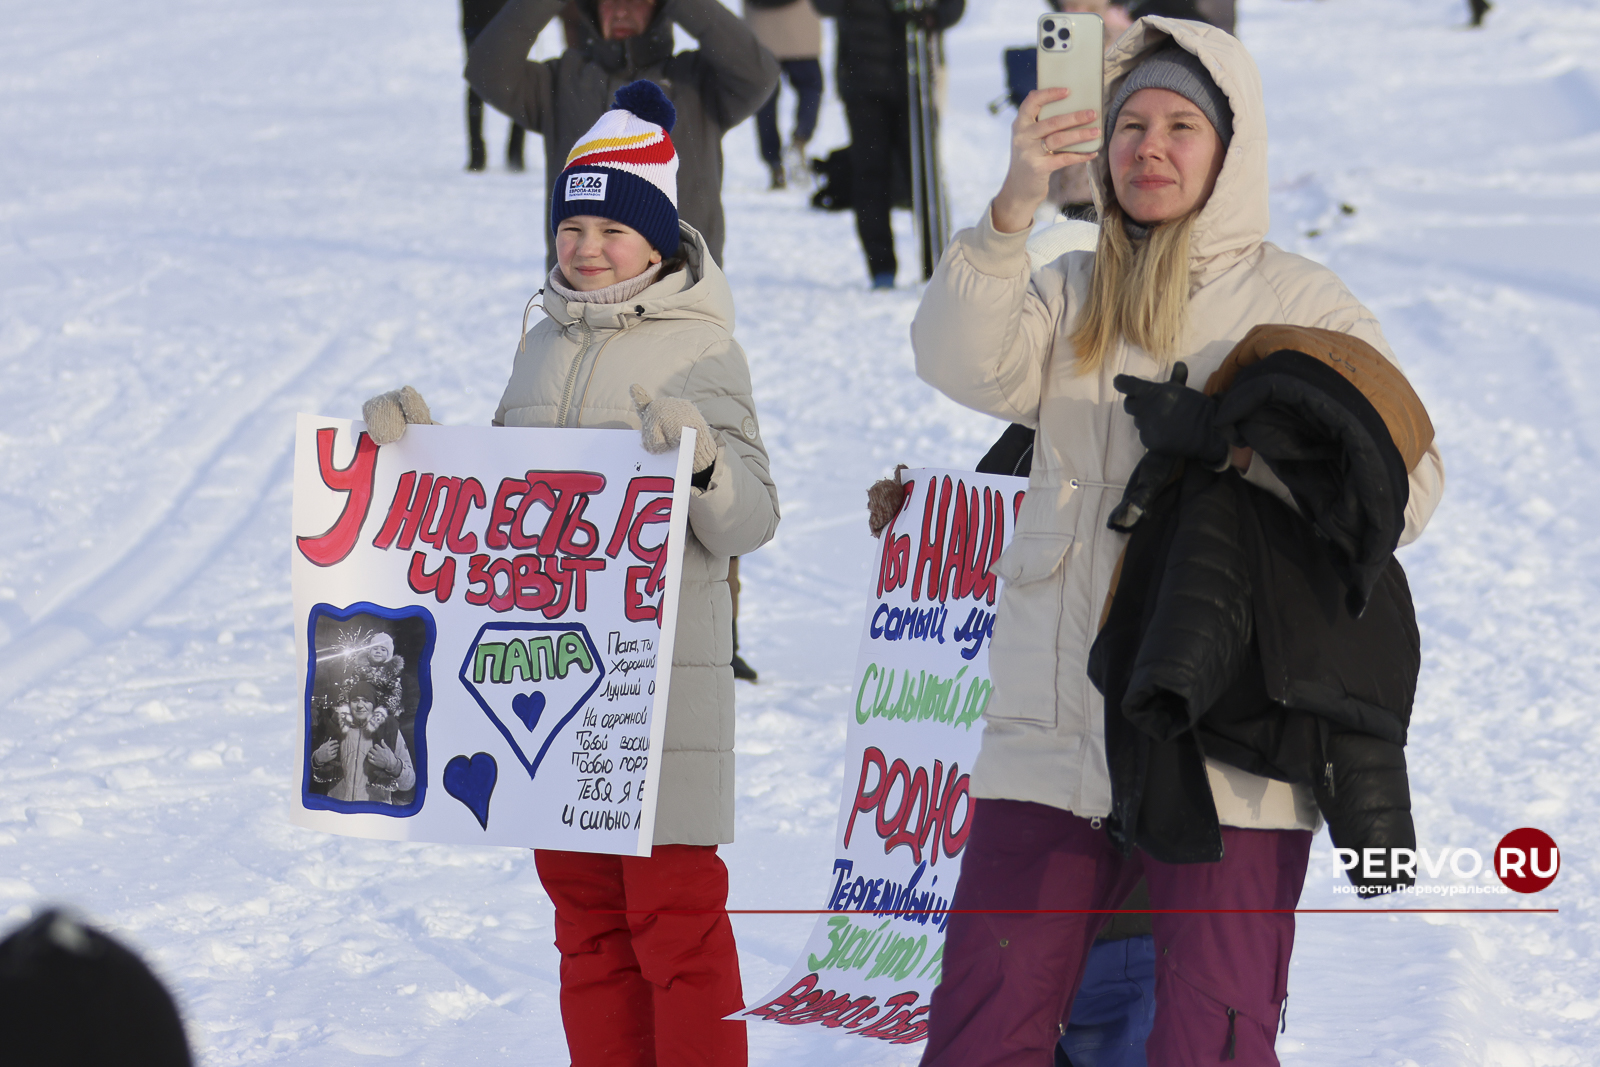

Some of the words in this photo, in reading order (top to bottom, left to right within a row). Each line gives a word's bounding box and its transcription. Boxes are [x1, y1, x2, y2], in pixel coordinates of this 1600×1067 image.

[297, 427, 380, 567] У
[485, 470, 606, 558] ЕСТЬ
[473, 631, 594, 684] ПАПА
